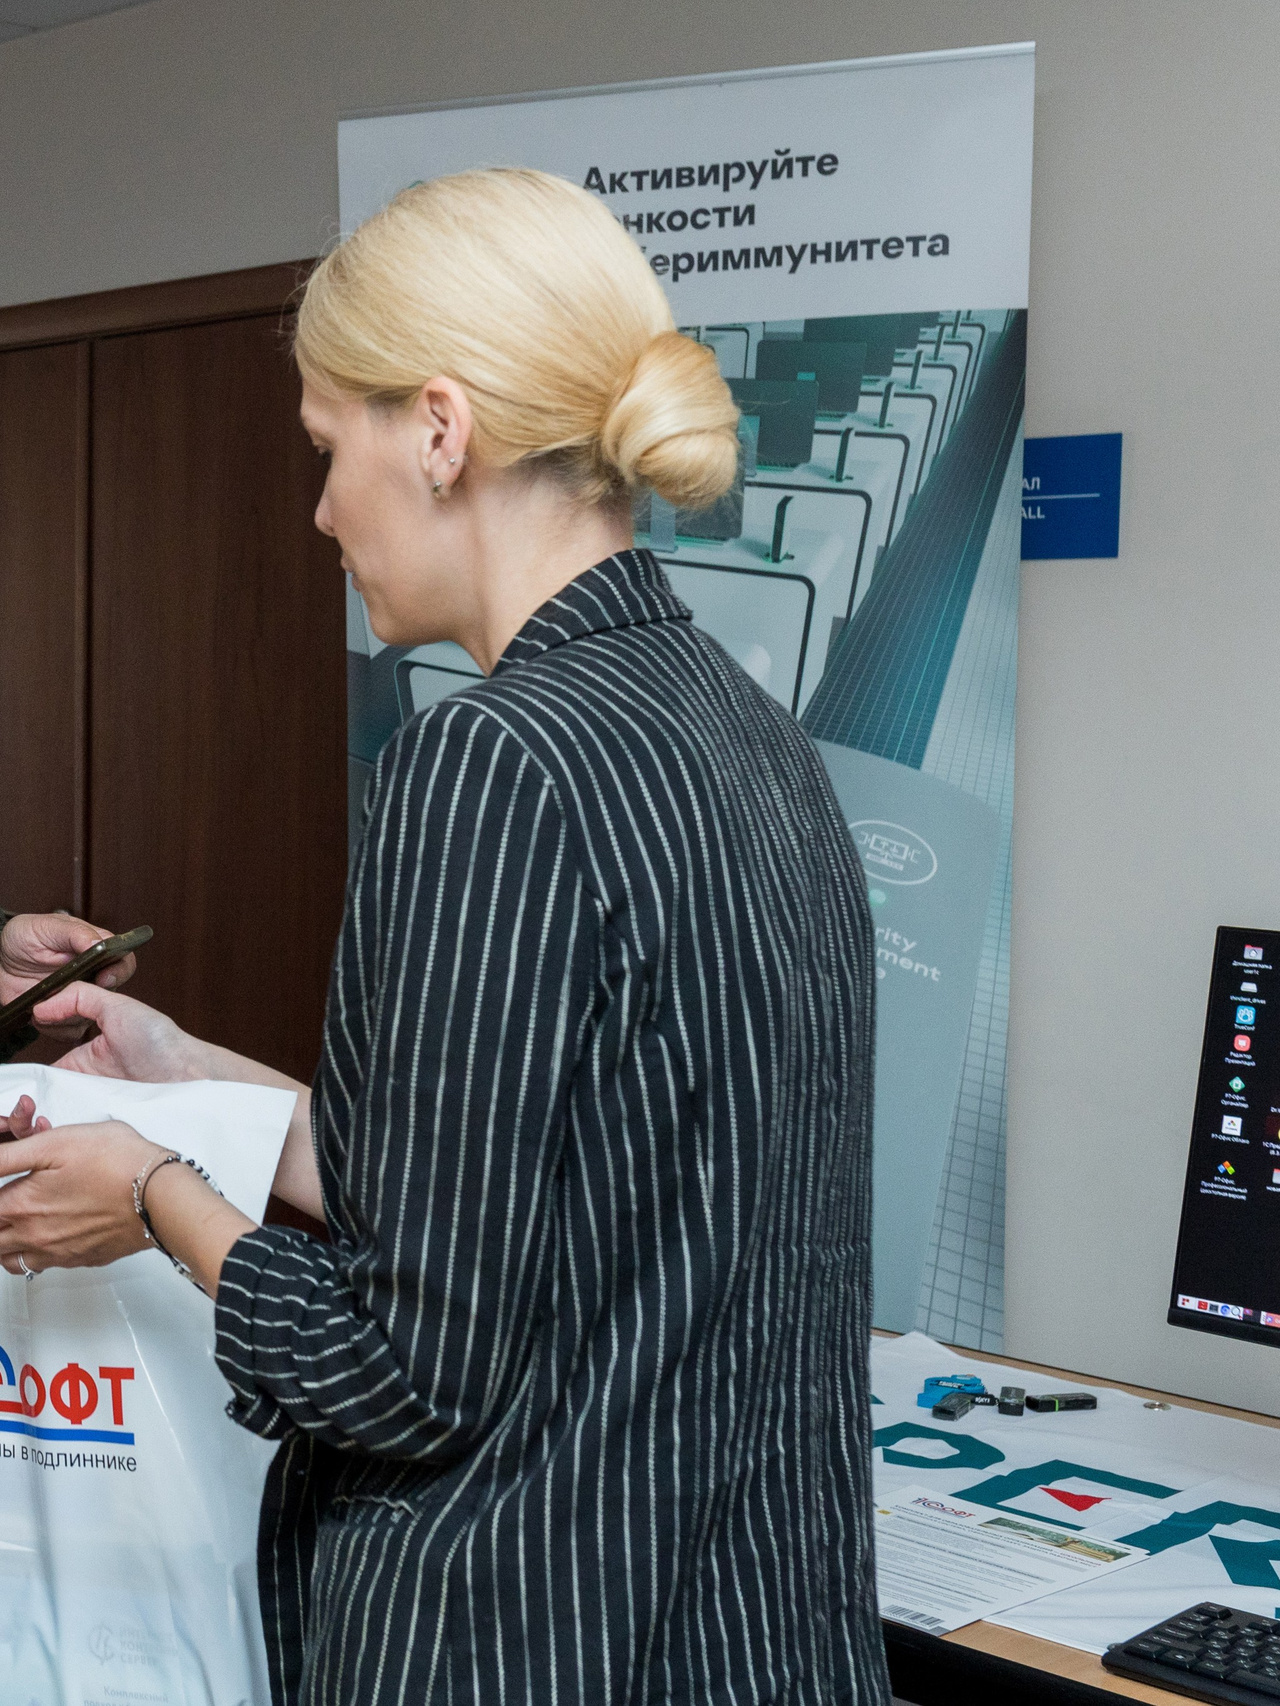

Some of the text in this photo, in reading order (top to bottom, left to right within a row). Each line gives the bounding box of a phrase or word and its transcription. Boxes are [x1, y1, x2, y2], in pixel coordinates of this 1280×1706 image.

[583, 148, 839, 194] Активируйте
[617, 204, 756, 234] нкости
[639, 233, 950, 282] ериммунитета
[1022, 476, 1041, 490] АЛ
[1021, 505, 1046, 519] ALL
[875, 926, 917, 953] rity
[876, 946, 942, 982] ment
[21, 1445, 30, 1460] в
[31, 1447, 138, 1472] подлиннике
